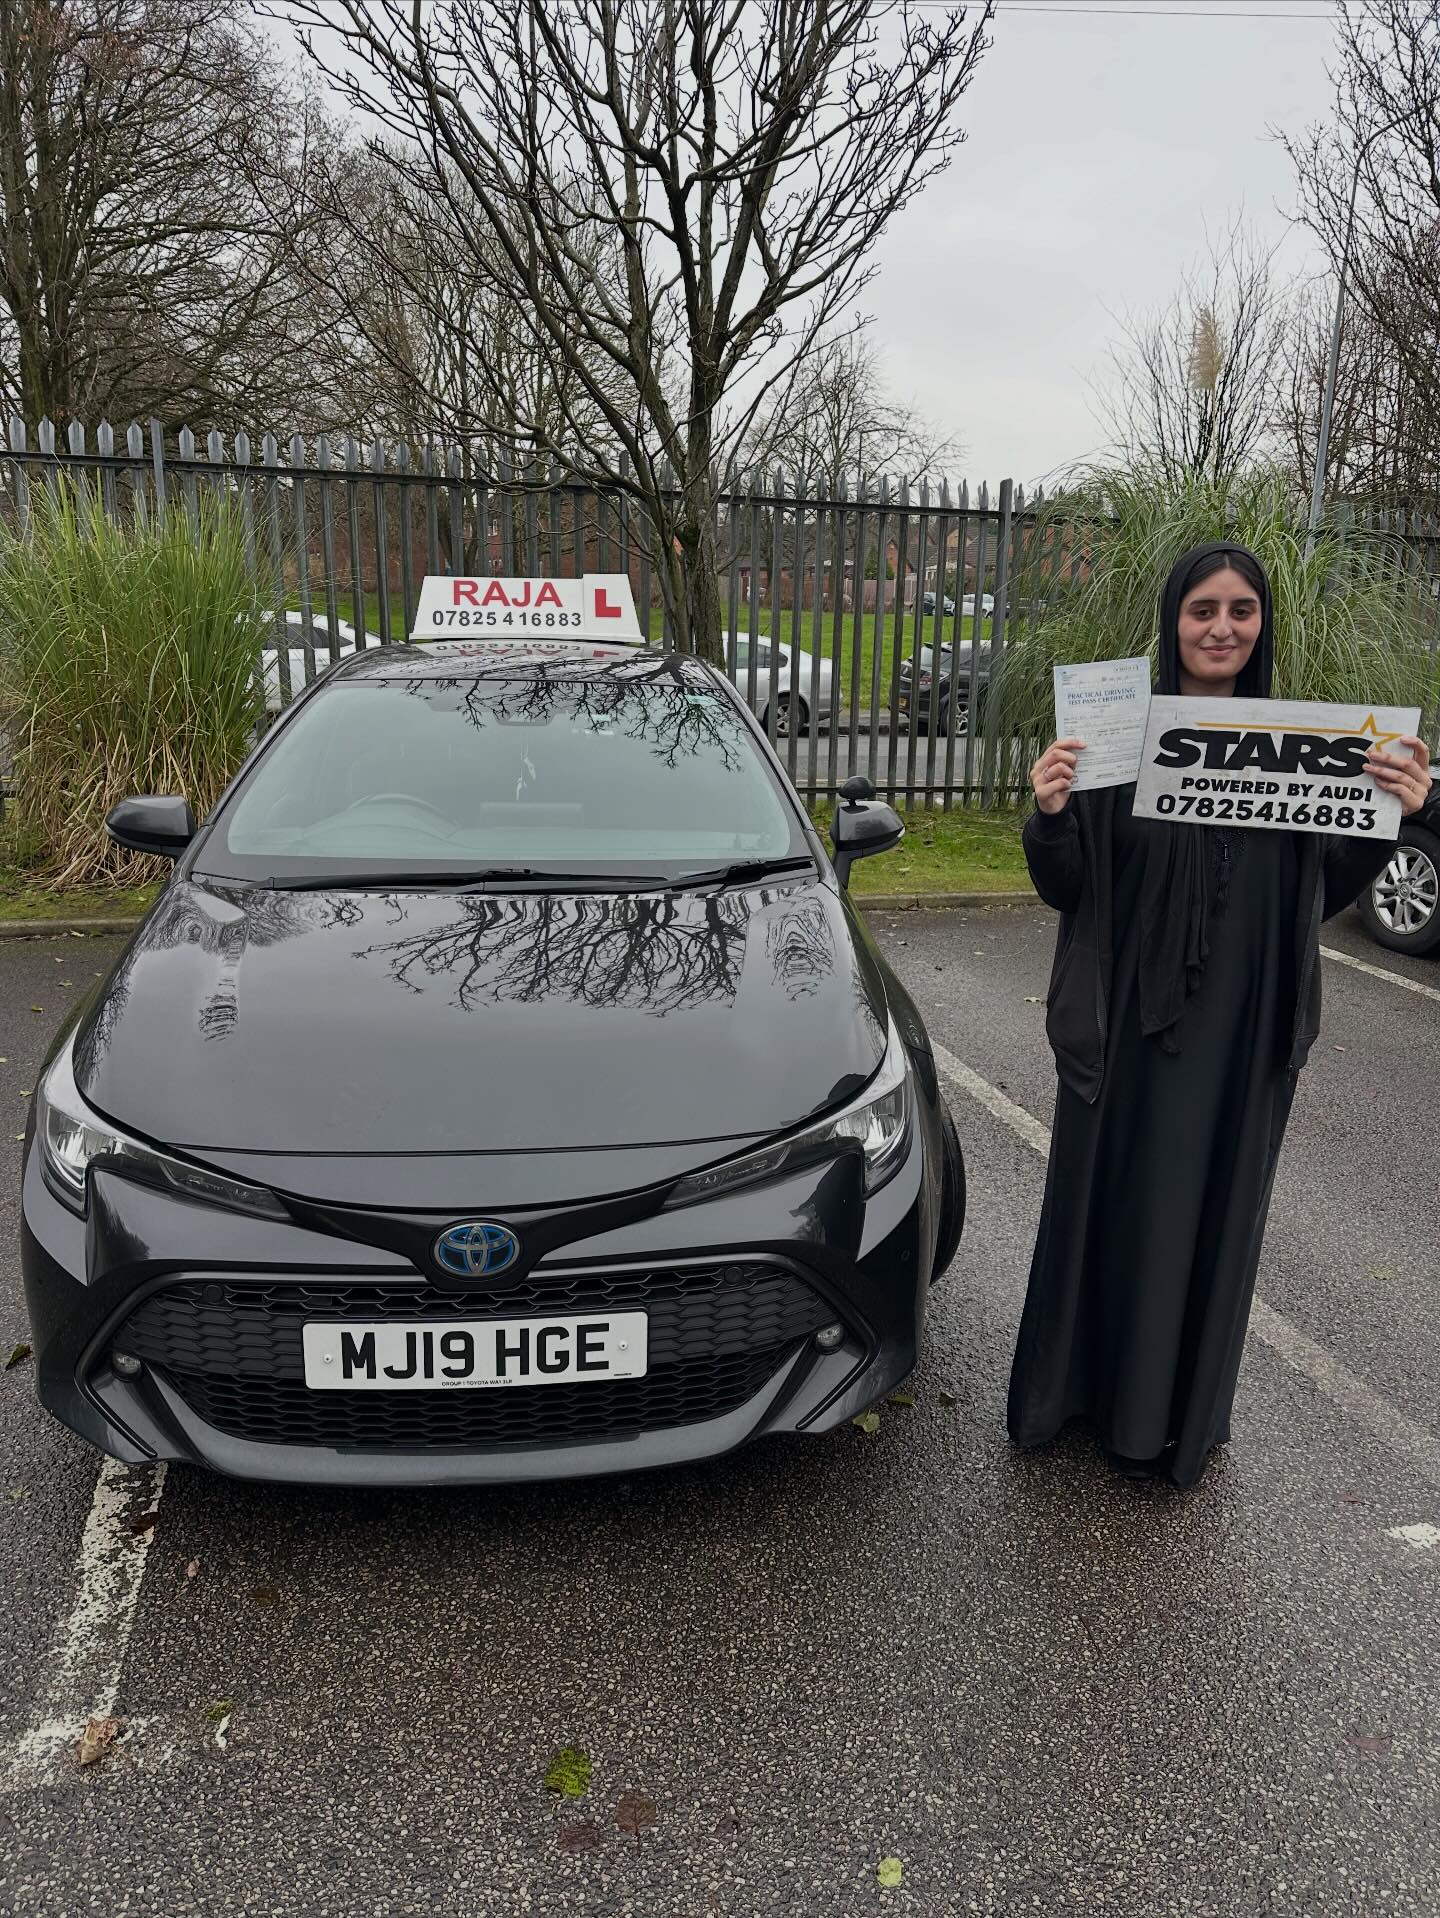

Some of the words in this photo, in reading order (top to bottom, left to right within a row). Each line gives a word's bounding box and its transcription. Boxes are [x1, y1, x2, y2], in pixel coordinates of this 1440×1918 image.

[453, 580, 563, 607] RAJA
[595, 588, 621, 618] L
[1153, 728, 1374, 777] STARS
[1181, 777, 1280, 795] POWERED
[1287, 782, 1314, 798] BY
[1318, 785, 1373, 802] AUDI
[1156, 794, 1377, 831] 07825416883
[341, 1331, 475, 1379] MJ19
[496, 1323, 610, 1376] HGE
